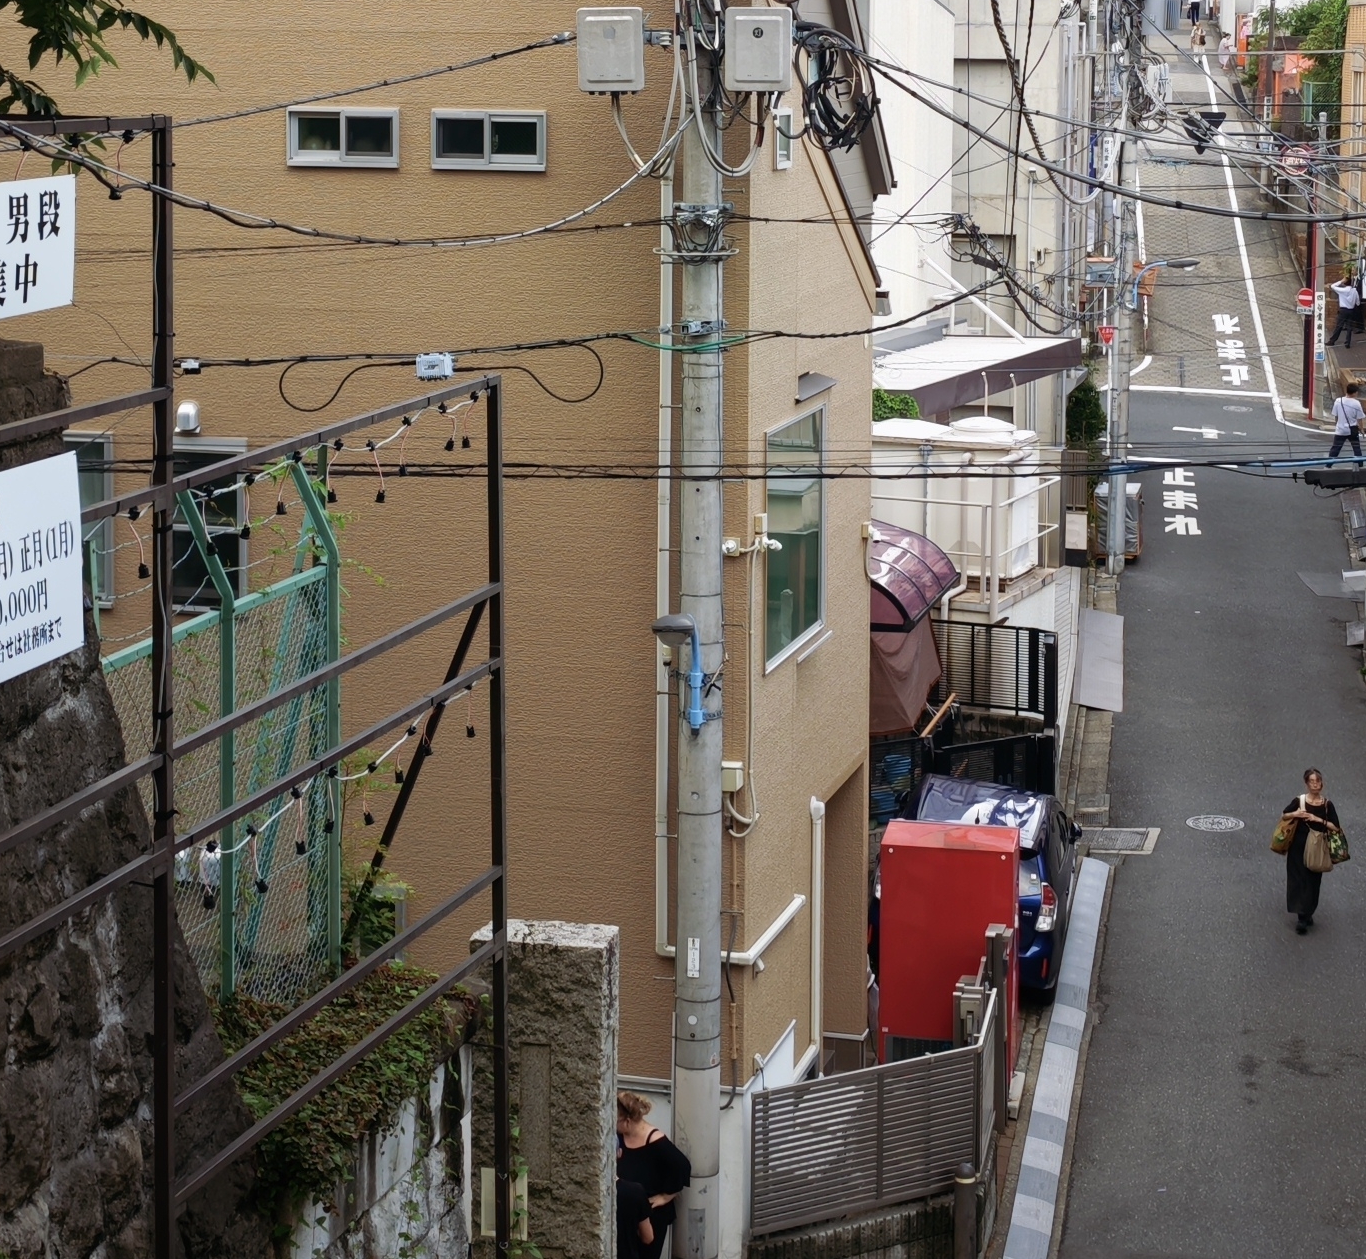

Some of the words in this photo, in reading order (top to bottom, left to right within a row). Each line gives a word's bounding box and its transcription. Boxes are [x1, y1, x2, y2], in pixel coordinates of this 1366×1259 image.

[6, 190, 61, 245] 男段
[1162, 467, 1202, 536] 止まれ
